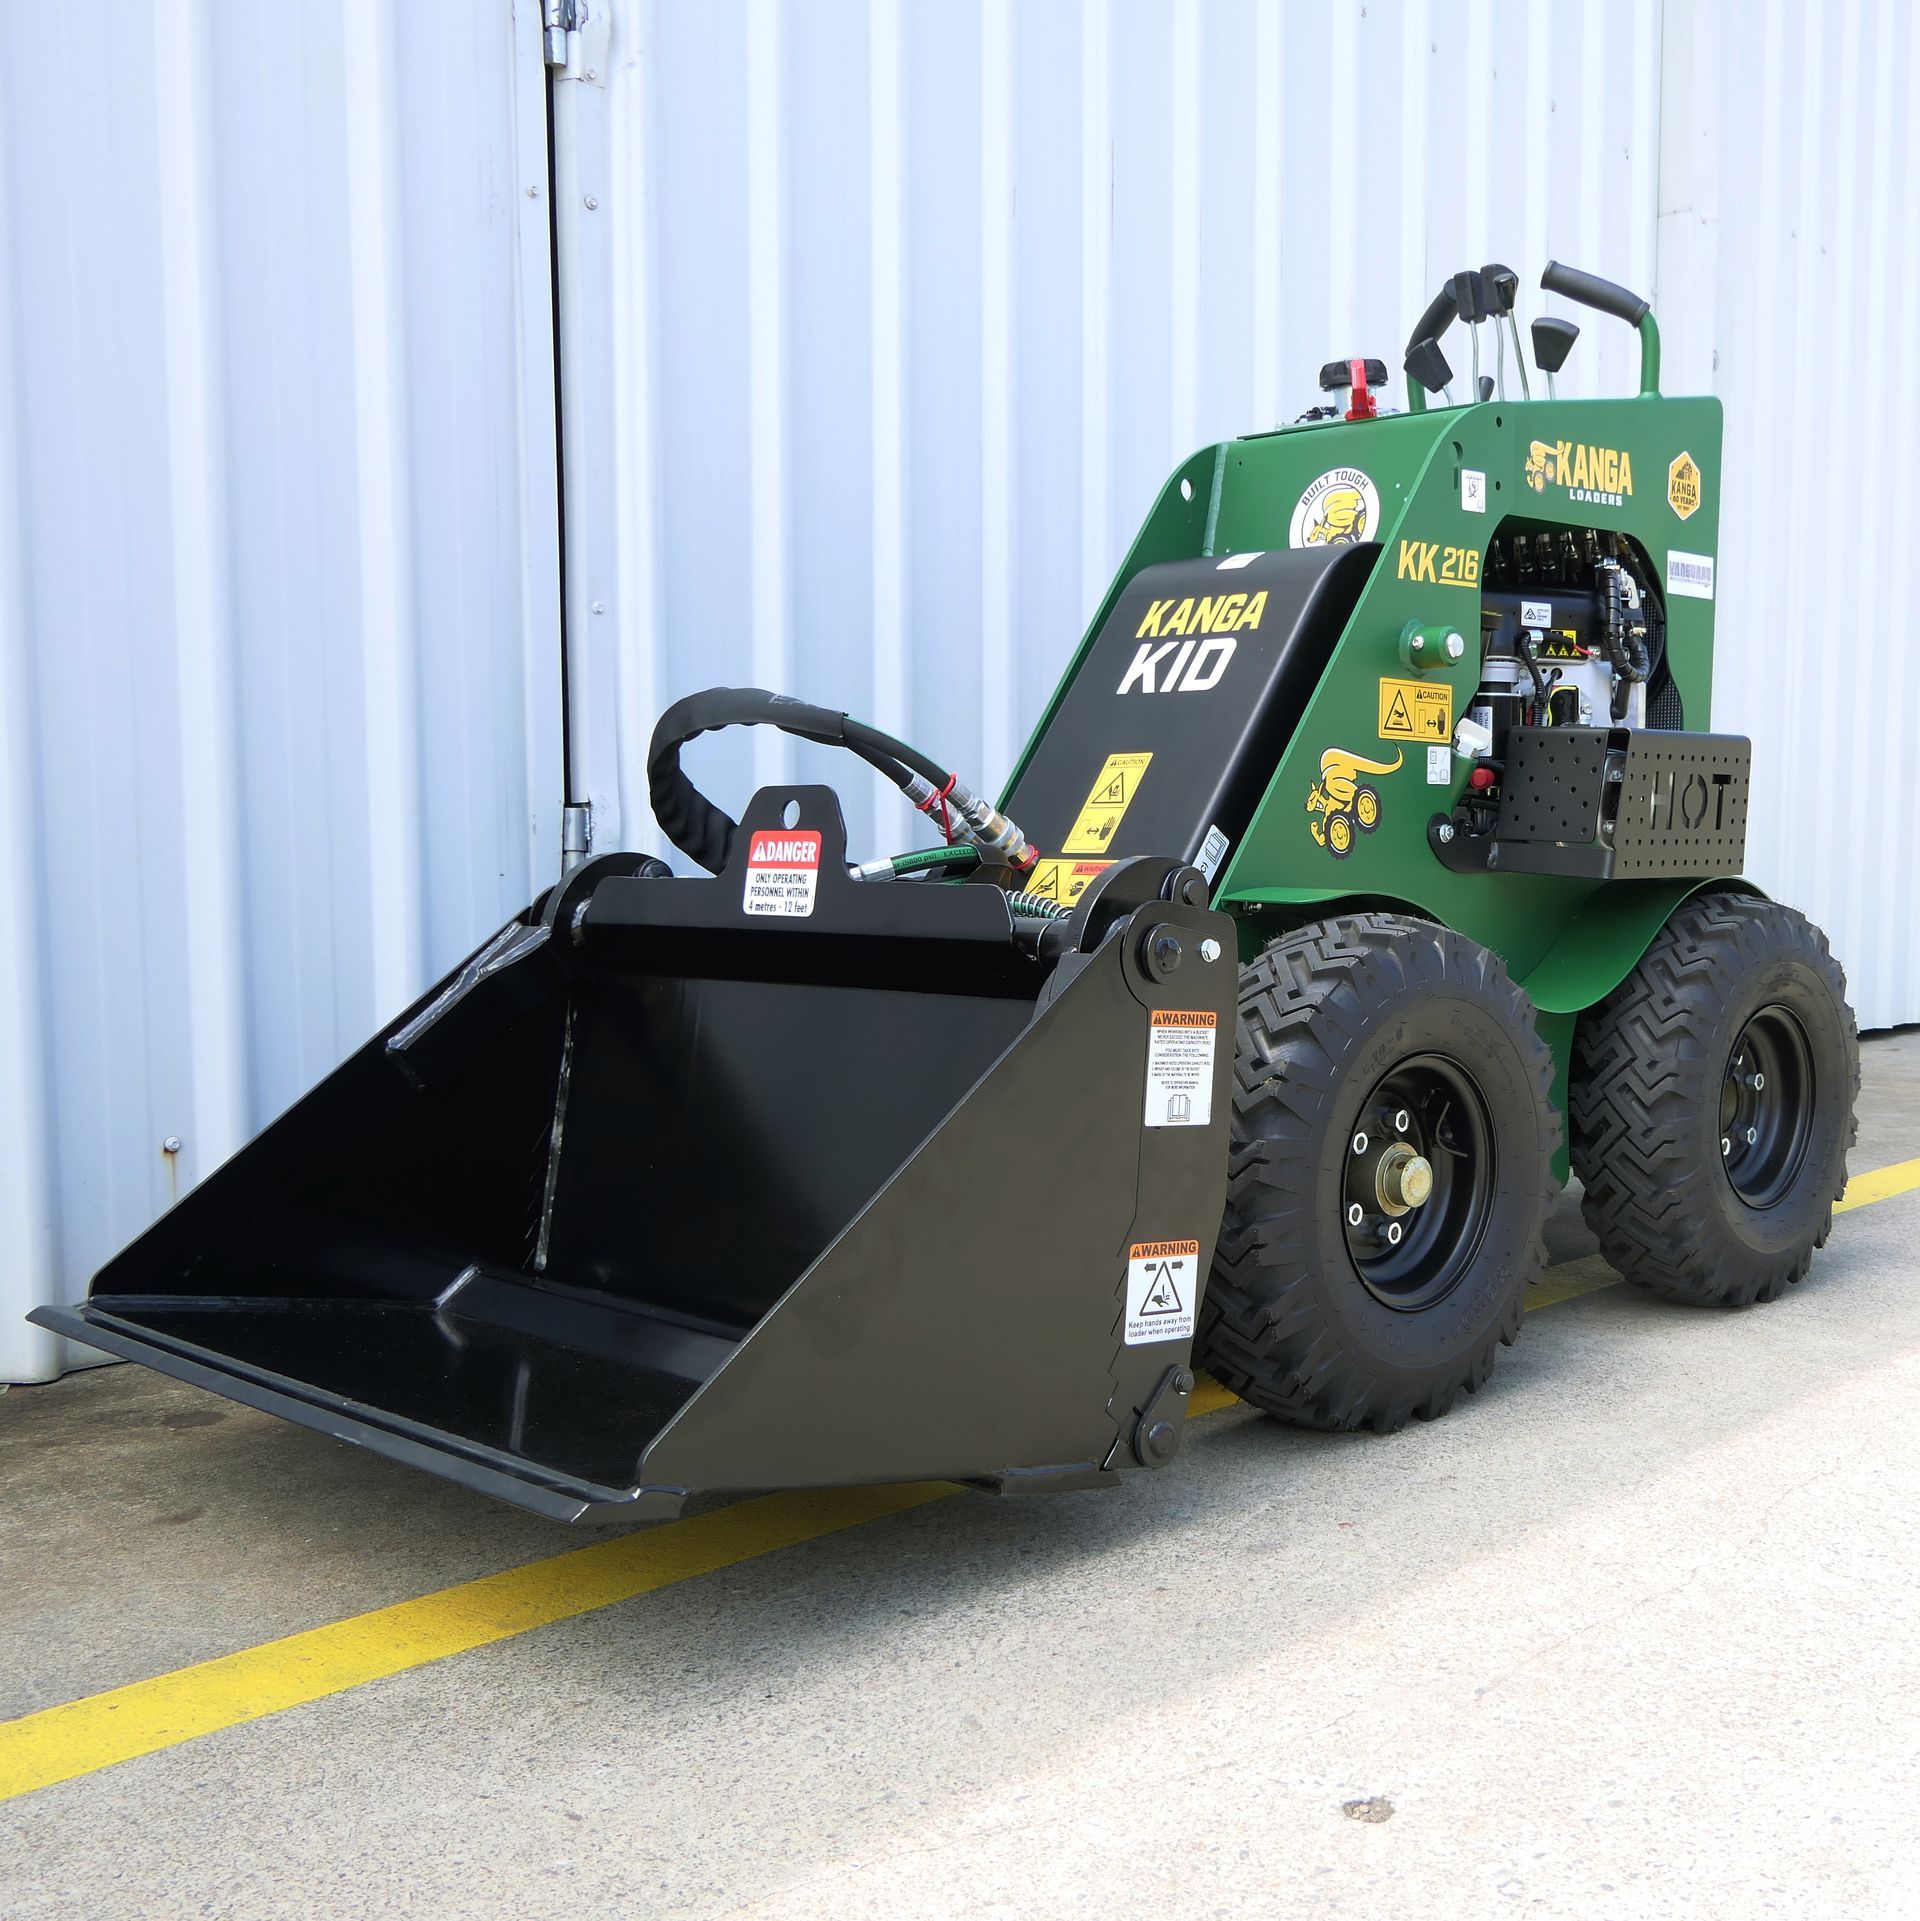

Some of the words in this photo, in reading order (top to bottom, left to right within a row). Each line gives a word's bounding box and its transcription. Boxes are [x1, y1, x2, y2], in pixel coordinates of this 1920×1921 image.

[1557, 440, 1633, 496] KANGA
[1302, 474, 1331, 506] BUILT
[1334, 470, 1369, 490] TOUGH
[1671, 480, 1696, 499] KANGA
[1569, 488, 1623, 507] LOADERS
[1397, 539, 1440, 583] KK
[1441, 546, 1479, 581] 216
[1669, 560, 1712, 582] VANGUARD
[1135, 591, 1269, 639] KANGA
[1116, 637, 1238, 695] KID
[1423, 691, 1448, 701] CAUTION
[1117, 758, 1145, 766] CAUTION
[1650, 771, 1732, 831] HOT
[766, 841, 817, 862] DANGER
[944, 848, 977, 858] EXCEEDS
[755, 873, 771, 883] ONLY
[773, 873, 807, 884] OPERATING
[750, 886, 785, 897] PERSONNEL
[786, 888, 809, 898] WITHIN
[749, 900, 754, 911] 4
[755, 902, 777, 912] metres
[784, 901, 793, 912] 12
[794, 901, 808, 913] feet
[1162, 1013, 1215, 1026] WARNING
[1141, 1241, 1197, 1257] WARNING
[1128, 1321, 1143, 1329] Keep
[1145, 1318, 1162, 1327] hands
[1163, 1317, 1178, 1326] away
[1178, 1315, 1192, 1324] from
[1128, 1330, 1147, 1338] loader
[1148, 1328, 1164, 1336] when
[1164, 1325, 1191, 1335] operating
